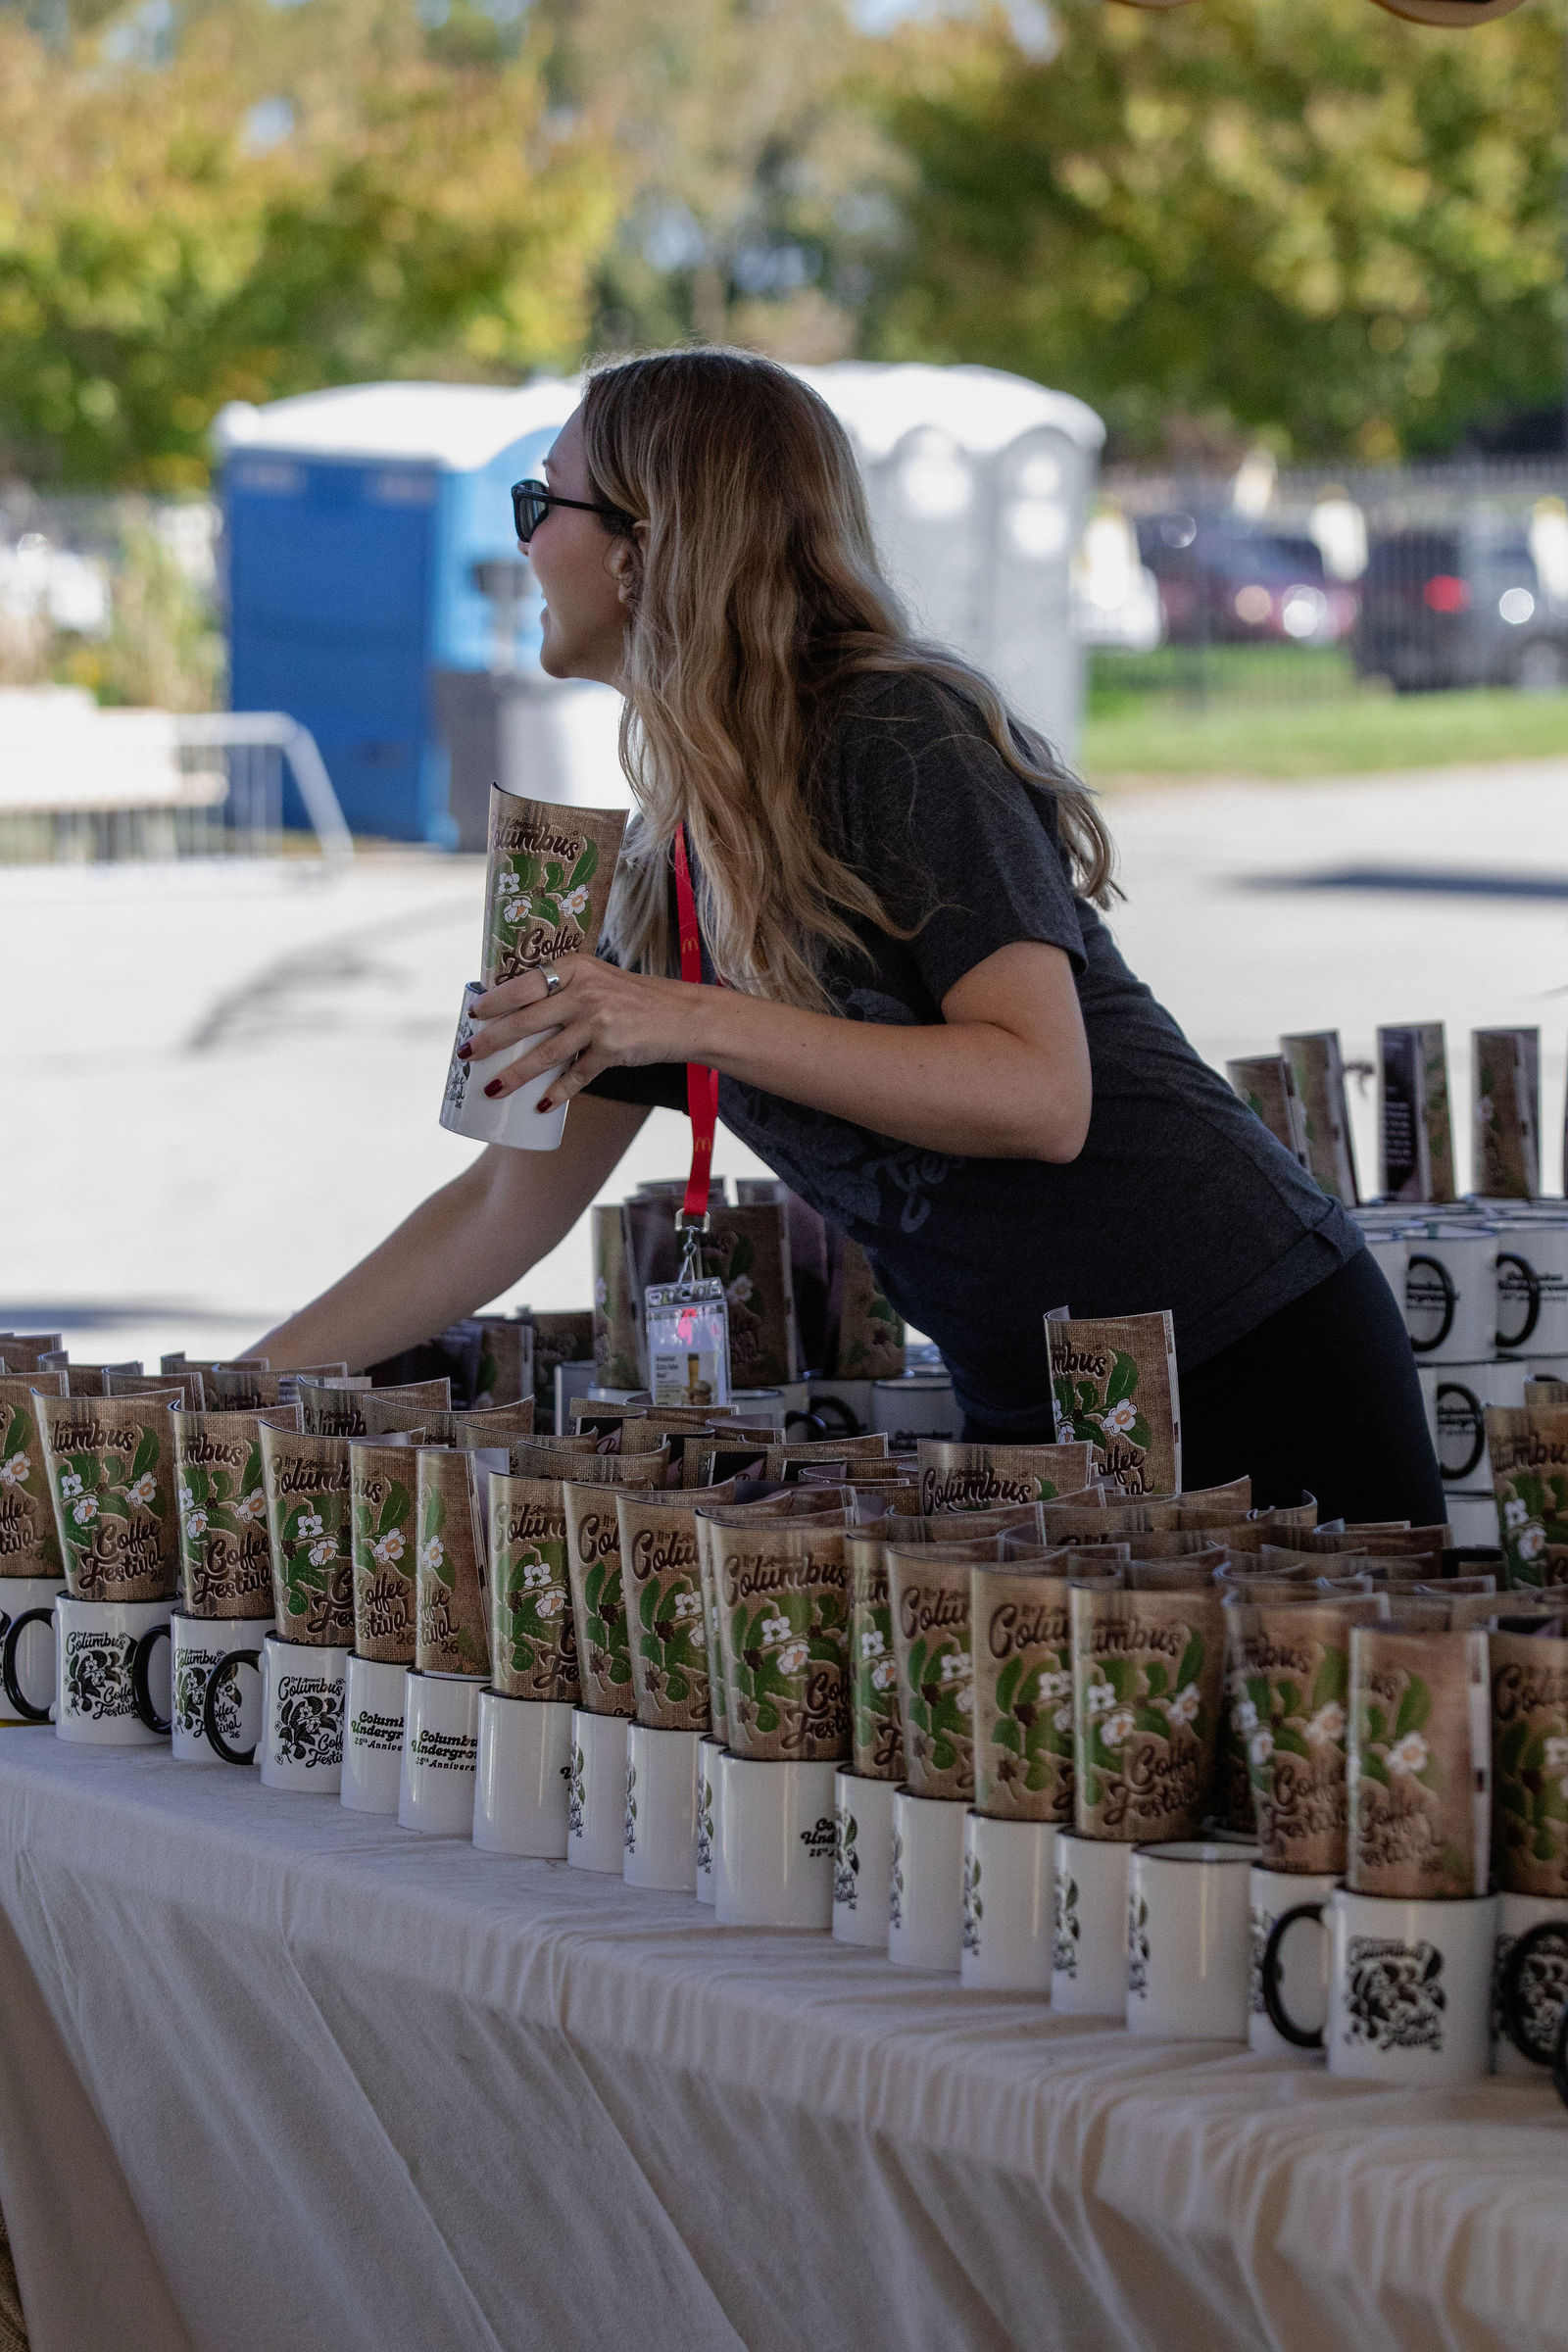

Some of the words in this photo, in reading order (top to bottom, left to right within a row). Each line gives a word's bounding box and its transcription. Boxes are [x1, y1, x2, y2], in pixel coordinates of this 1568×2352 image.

[519, 930, 582, 961] Coffee
[1052, 1342, 1106, 1377] mbus
[50, 1420, 135, 1451] lumbus
[305, 1410, 367, 1437] Columb
[1099, 1445, 1146, 1485] offee
[922, 1466, 1031, 1516] Columbus
[0, 1494, 38, 1532] ffee
[0, 1519, 46, 1555] tival
[97, 1516, 162, 1560] Coffee
[78, 1537, 165, 1590] Festival
[207, 1531, 270, 1575] Coffee
[723, 1551, 847, 1608] Columbus
[66, 1631, 126, 1656] Columbus
[440, 1640, 460, 1654] 26
[103, 1684, 134, 1703] Coffe
[278, 1676, 343, 1701] Columbus
[92, 1700, 139, 1720] Festiva
[359, 1710, 404, 1728] Colum
[318, 1731, 343, 1752] Coff
[351, 1720, 404, 1741] Undergr
[419, 1730, 478, 1747] Columbu
[368, 1740, 403, 1752] Annive
[411, 1740, 477, 1761] Undergro
[429, 1758, 475, 1772] Annivers
